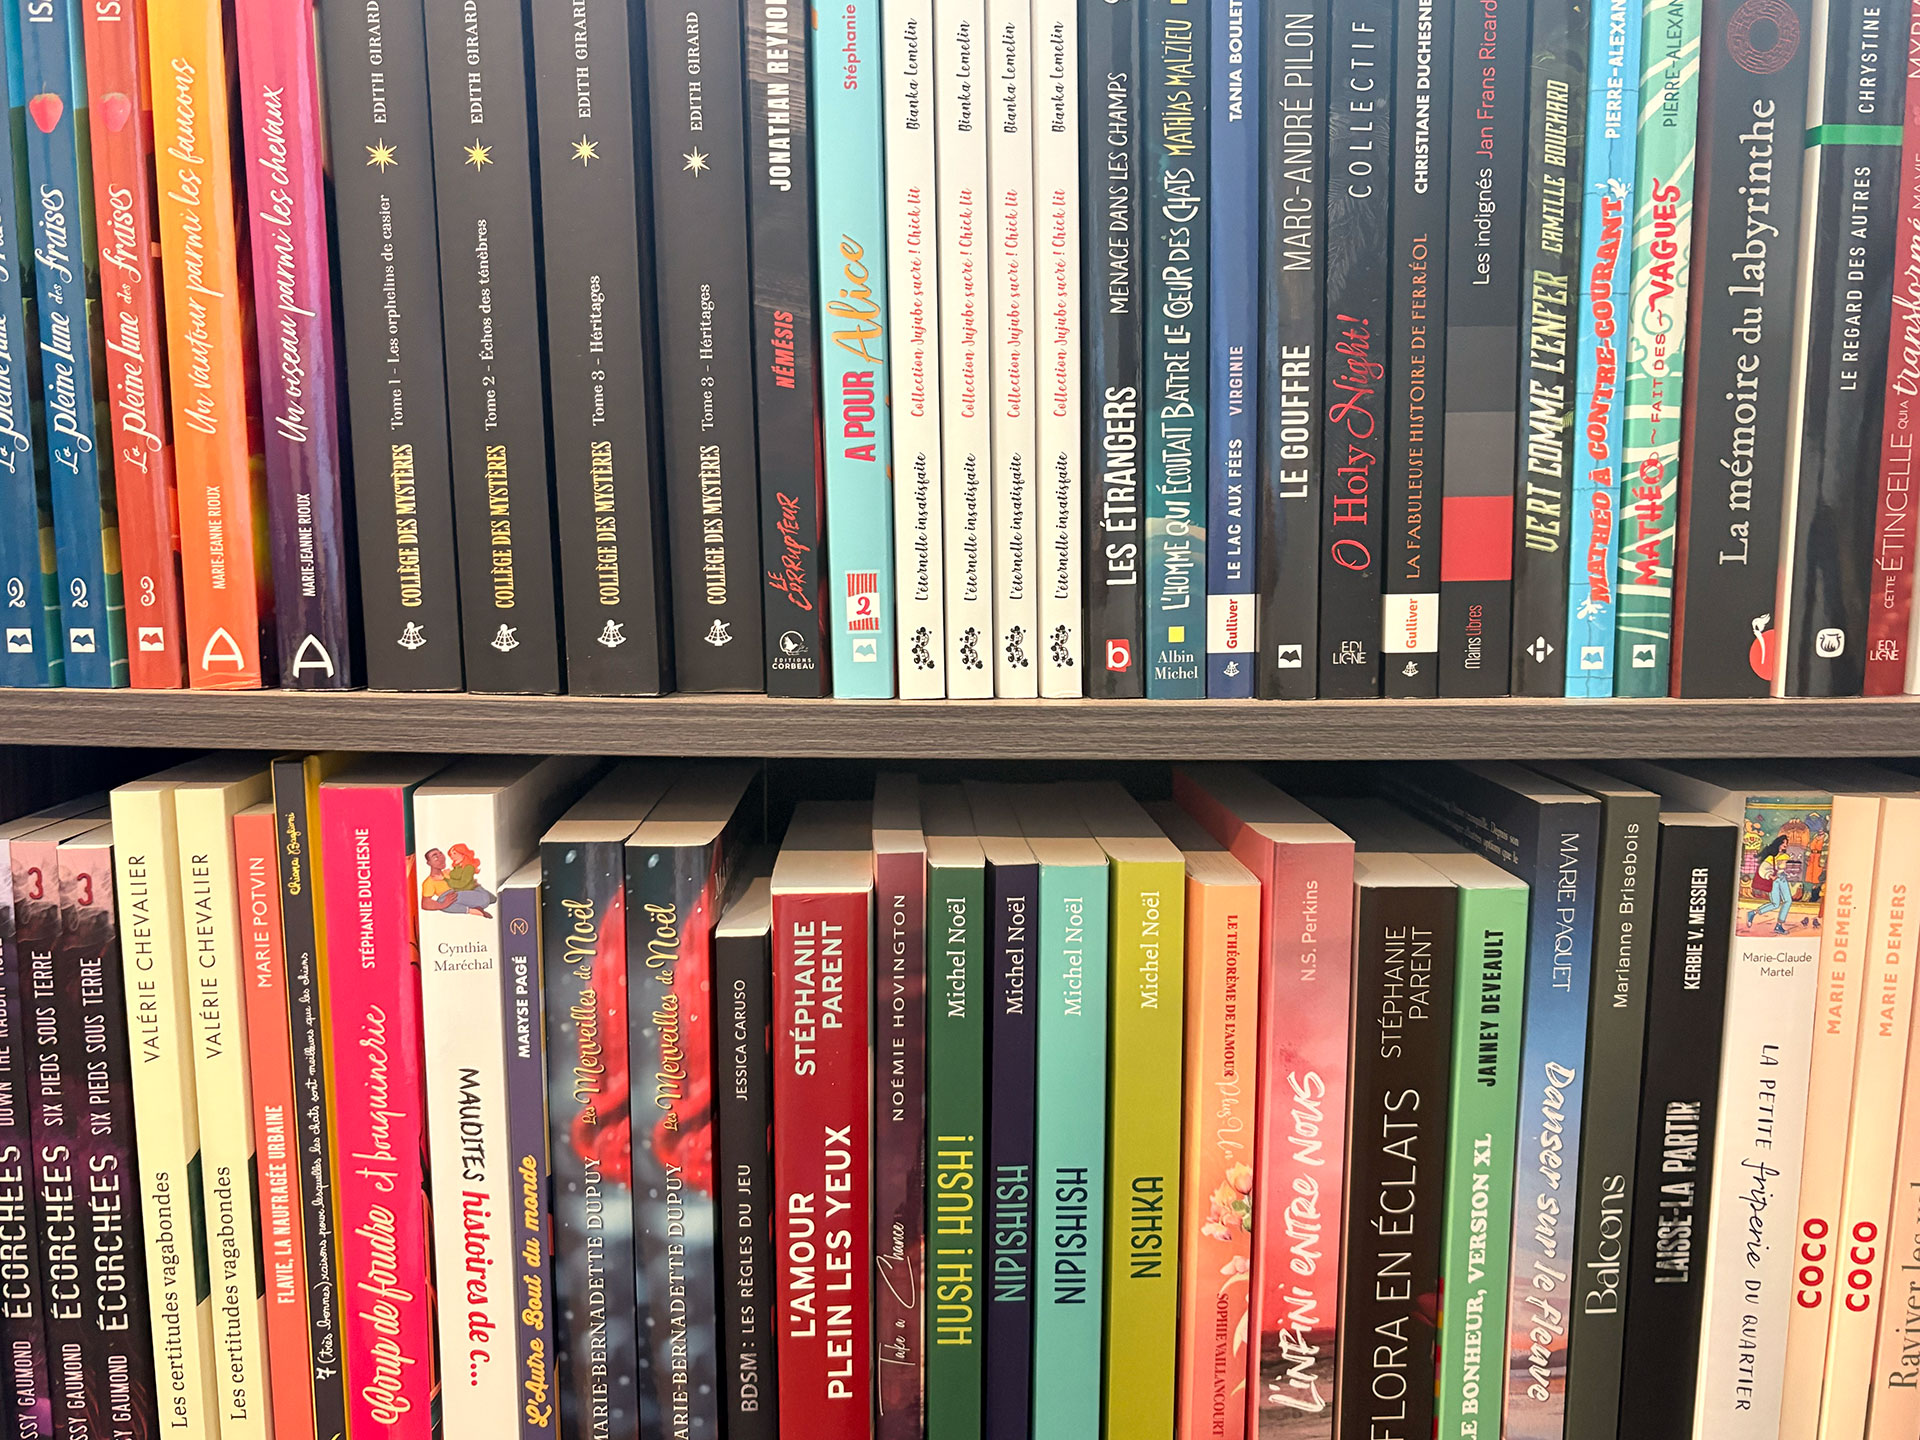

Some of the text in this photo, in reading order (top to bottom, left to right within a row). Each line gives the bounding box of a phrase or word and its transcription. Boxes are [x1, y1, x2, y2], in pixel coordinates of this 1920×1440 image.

[686, 12, 703, 130] EDITH GIRARD
[842, 5, 861, 89] Stéphanie
[904, 18, 920, 129] Bianka Lemelin
[1162, 20, 1195, 155] MATHIAS MALZIEU
[1229, 0, 1242, 122] TANIA BOULET
[1415, 0, 1432, 193] CHRISTIANE DUCHESNE
[1476, 0, 1497, 159] Jan Frans Ricard
[1859, 8, 1880, 112] CHRYSTINE
[767, 84, 792, 192] JONATHAN
[1108, 73, 1130, 314] MENACE DANS LES CHAMPS
[1279, 14, 1314, 270] MARC-ANDRÉ PILON
[1542, 80, 1568, 253] CAMILLE BOUCHARD
[475, 219, 489, 284] ténèbres
[1473, 169, 1495, 284] Les indignés
[1841, 167, 1870, 389] LE REGARD DES AUTRES
[478, 316, 495, 360] Échos
[479, 288, 491, 313] des
[827, 233, 886, 462] A POUR Alice
[1719, 99, 1778, 564] La mémoire du labyrinthe
[483, 376, 495, 386] 2
[485, 390, 497, 431] Tome
[1229, 347, 1242, 416] VIRGINIE
[1280, 346, 1310, 497] LE GOUFFRE
[207, 486, 225, 589] MARIE-JEANNE RIOUX
[485, 445, 514, 608] COLLÈGE DES MYSTÈRES
[1100, 386, 1138, 585] LES ÉTRANGERS
[1225, 439, 1242, 579] LE LAC AUX FÉES
[771, 662, 815, 670] CORBEAU
[1155, 666, 1198, 679] Michel
[1158, 650, 1193, 663] Albin
[1226, 599, 1238, 649] Gulliver
[1465, 605, 1482, 668] Mains Libres
[285, 813, 301, 895] Chiara Baglioni
[356, 829, 375, 968] STÉPHANIE DUCHESNE
[1553, 834, 1579, 992] MARIE PAQUET
[129, 856, 160, 1063] VALÉRIE CHEVALIER
[249, 858, 272, 987] MARIE POTVIN
[297, 952, 310, 986] chiens
[435, 958, 492, 971] Maréchal
[438, 941, 487, 956] Cynthia
[822, 921, 842, 1028] PARENT
[946, 897, 966, 1018] Michel Noël
[1301, 881, 1317, 980] N.S. Perkins
[1409, 926, 1432, 1018] PARENT
[1613, 824, 1639, 1007] Marianne Brisebois
[1684, 869, 1708, 989] KERBIE V. MESSIER
[1743, 952, 1812, 962] Marie-Claude
[1761, 967, 1793, 976] Martel
[1827, 883, 1856, 1034] MARIE DEMERS
[80, 957, 112, 1136] SIX PIEDS SOUS TERRE
[298, 988, 311, 1004] les
[305, 1006, 316, 1026] que
[512, 956, 530, 1058] MARYSE PAGÉ
[734, 980, 747, 1100] JESSICA CARUSO
[790, 922, 815, 1075] STÉPHANIE
[891, 896, 905, 1121] NOÉMIE HOVINGTON
[1224, 914, 1238, 1076] LE THÉORÈME DE L'AMOUR
[1378, 926, 1405, 1058] STÉPHANIE
[1478, 930, 1503, 1086] JANNEY DEVEAULT
[306, 1078, 320, 1102] sont
[307, 1105, 321, 1134] chats
[309, 1138, 322, 1155] les
[88, 1155, 128, 1330] ÉCORCHÉES
[265, 1106, 295, 1303] FLAVIE, LA NAUFRAGÉE URBAINE
[994, 1166, 1028, 1301] NIPISHISH
[1131, 1177, 1163, 1278] NISHKA
[1585, 1175, 1625, 1313] Balcons
[1655, 1102, 1700, 1282] LAISSE-LA PARTIR
[1735, 1045, 1780, 1410] LA PETITE friperie DU QUARTIER
[152, 1172, 187, 1428] Les certitudes vagabondes
[789, 1193, 815, 1336] L'AMOUR
[825, 1125, 852, 1398] PLEIN LES YEUX
[1462, 1134, 1491, 1415] BONHEUR, VERSION XL
[1797, 1219, 1828, 1308] COCO
[108, 1355, 133, 1422] GAUMOND
[316, 1367, 336, 1380] 7
[1213, 1293, 1229, 1437] SOPHIE VAILLANCOURT
